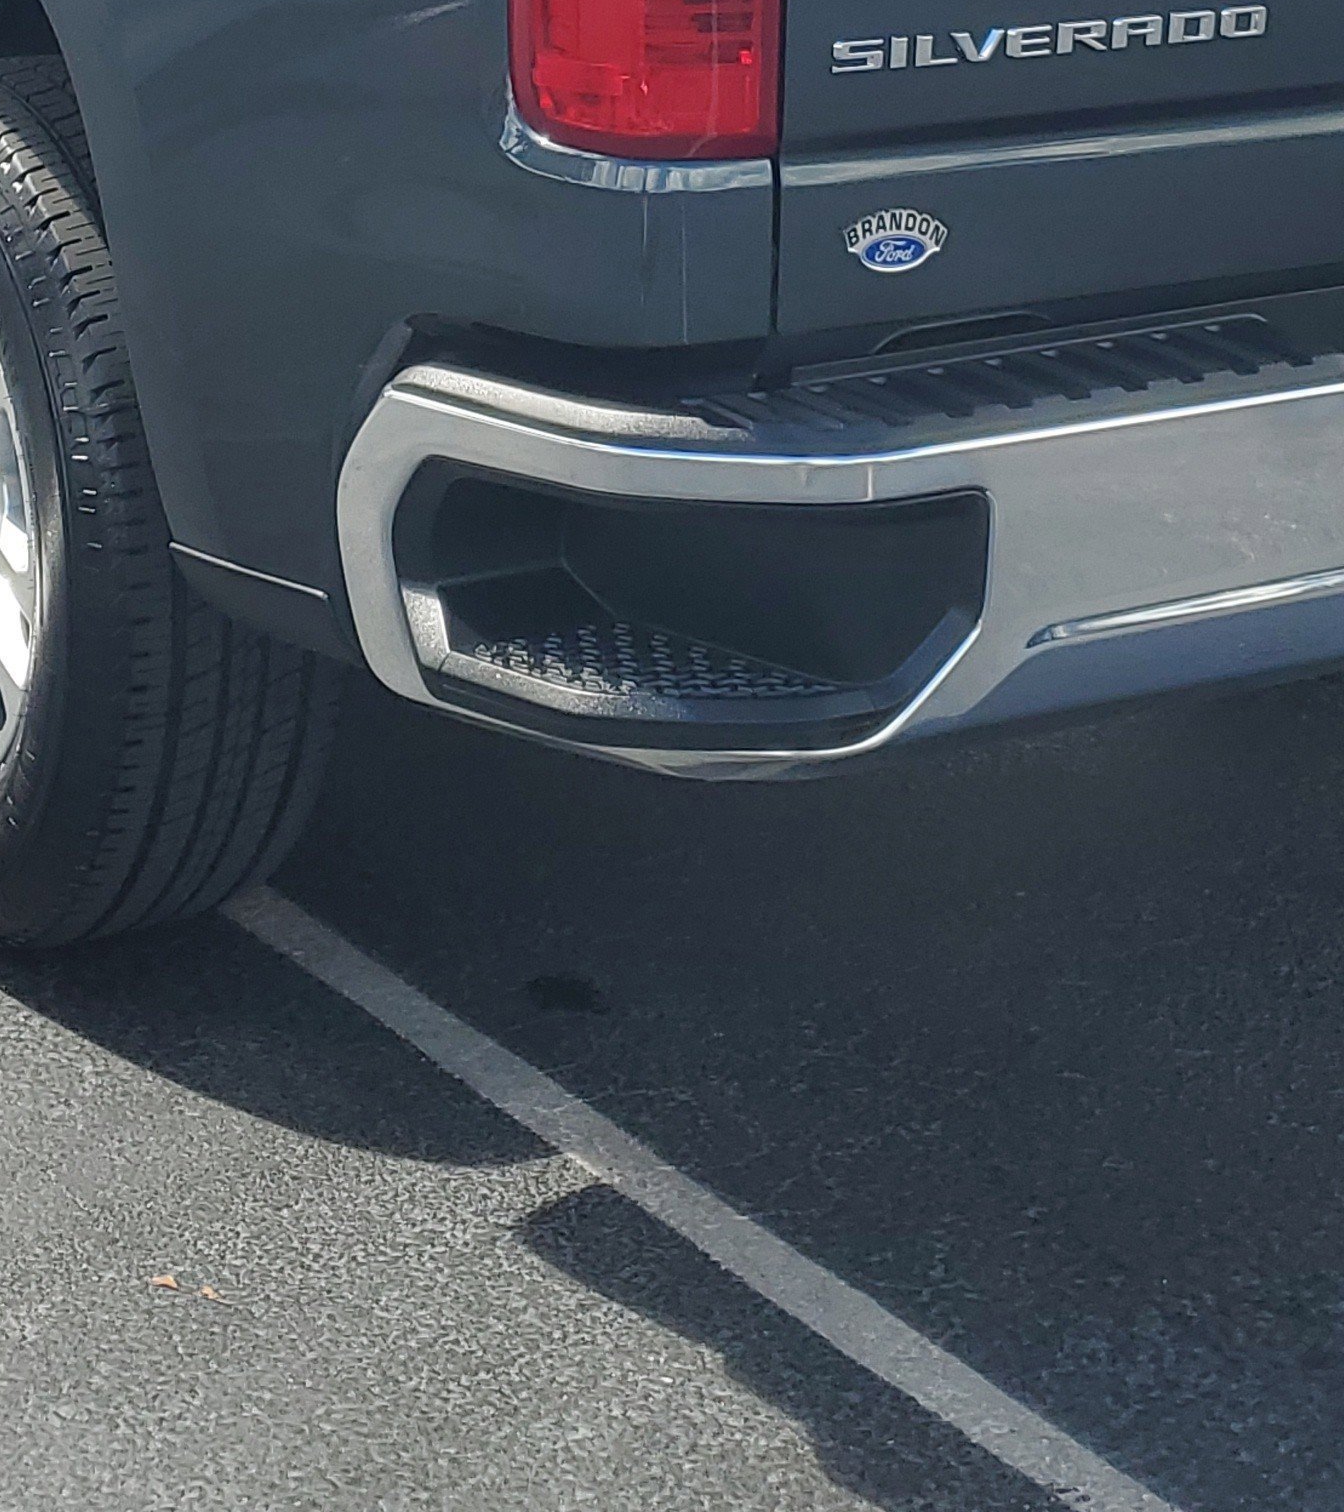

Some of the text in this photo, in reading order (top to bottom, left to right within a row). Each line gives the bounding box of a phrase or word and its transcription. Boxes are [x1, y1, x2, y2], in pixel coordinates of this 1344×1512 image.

[831, 4, 1268, 74] SILVERADO
[847, 211, 945, 248] BRANDON
[874, 240, 916, 262] Ford
